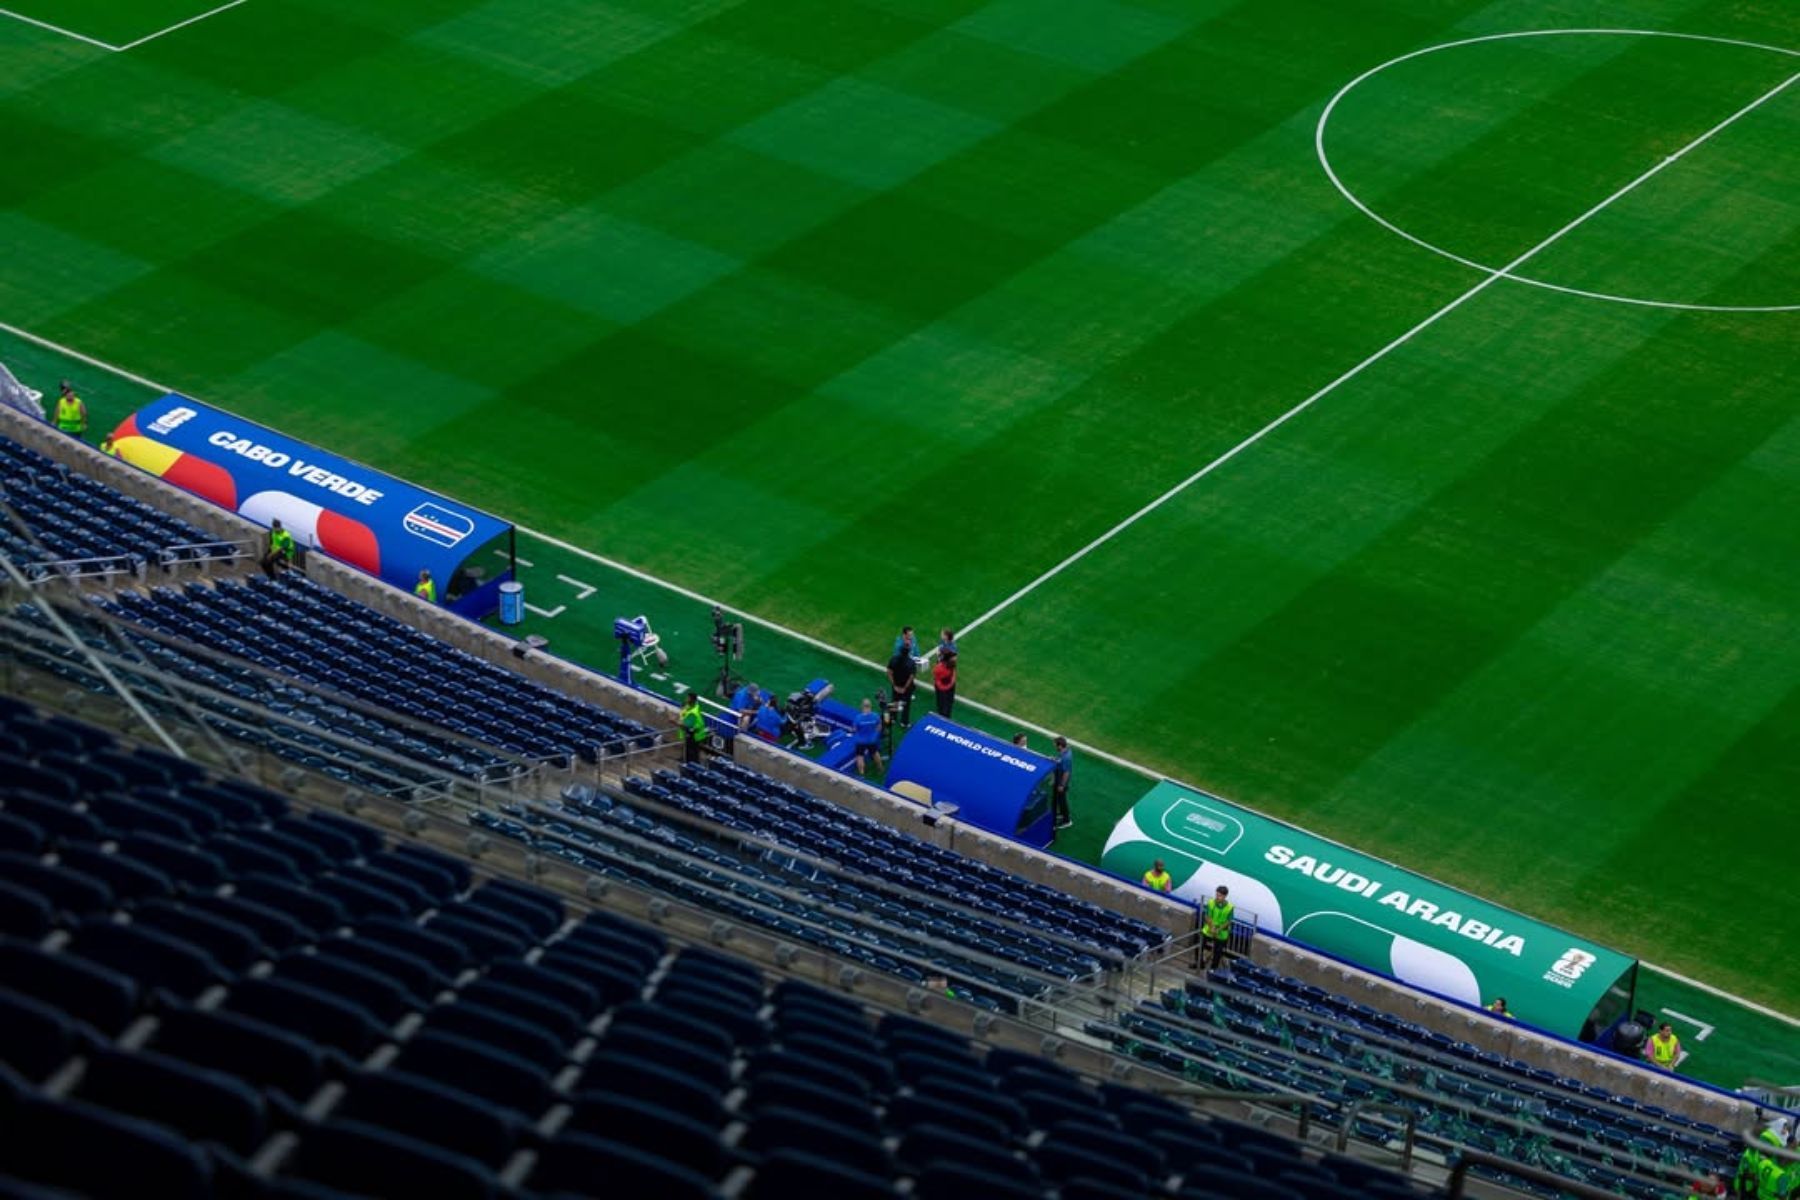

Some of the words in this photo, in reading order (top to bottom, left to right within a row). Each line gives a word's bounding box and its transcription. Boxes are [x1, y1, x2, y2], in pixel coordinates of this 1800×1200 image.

[208, 431, 291, 467] CABO
[288, 461, 384, 506] VERDE
[924, 725, 947, 738] FIFA
[946, 733, 982, 751] WORLD
[981, 747, 1002, 758] CUP
[1264, 845, 1383, 898] SAUDI
[1378, 891, 1525, 956] ARABIA
